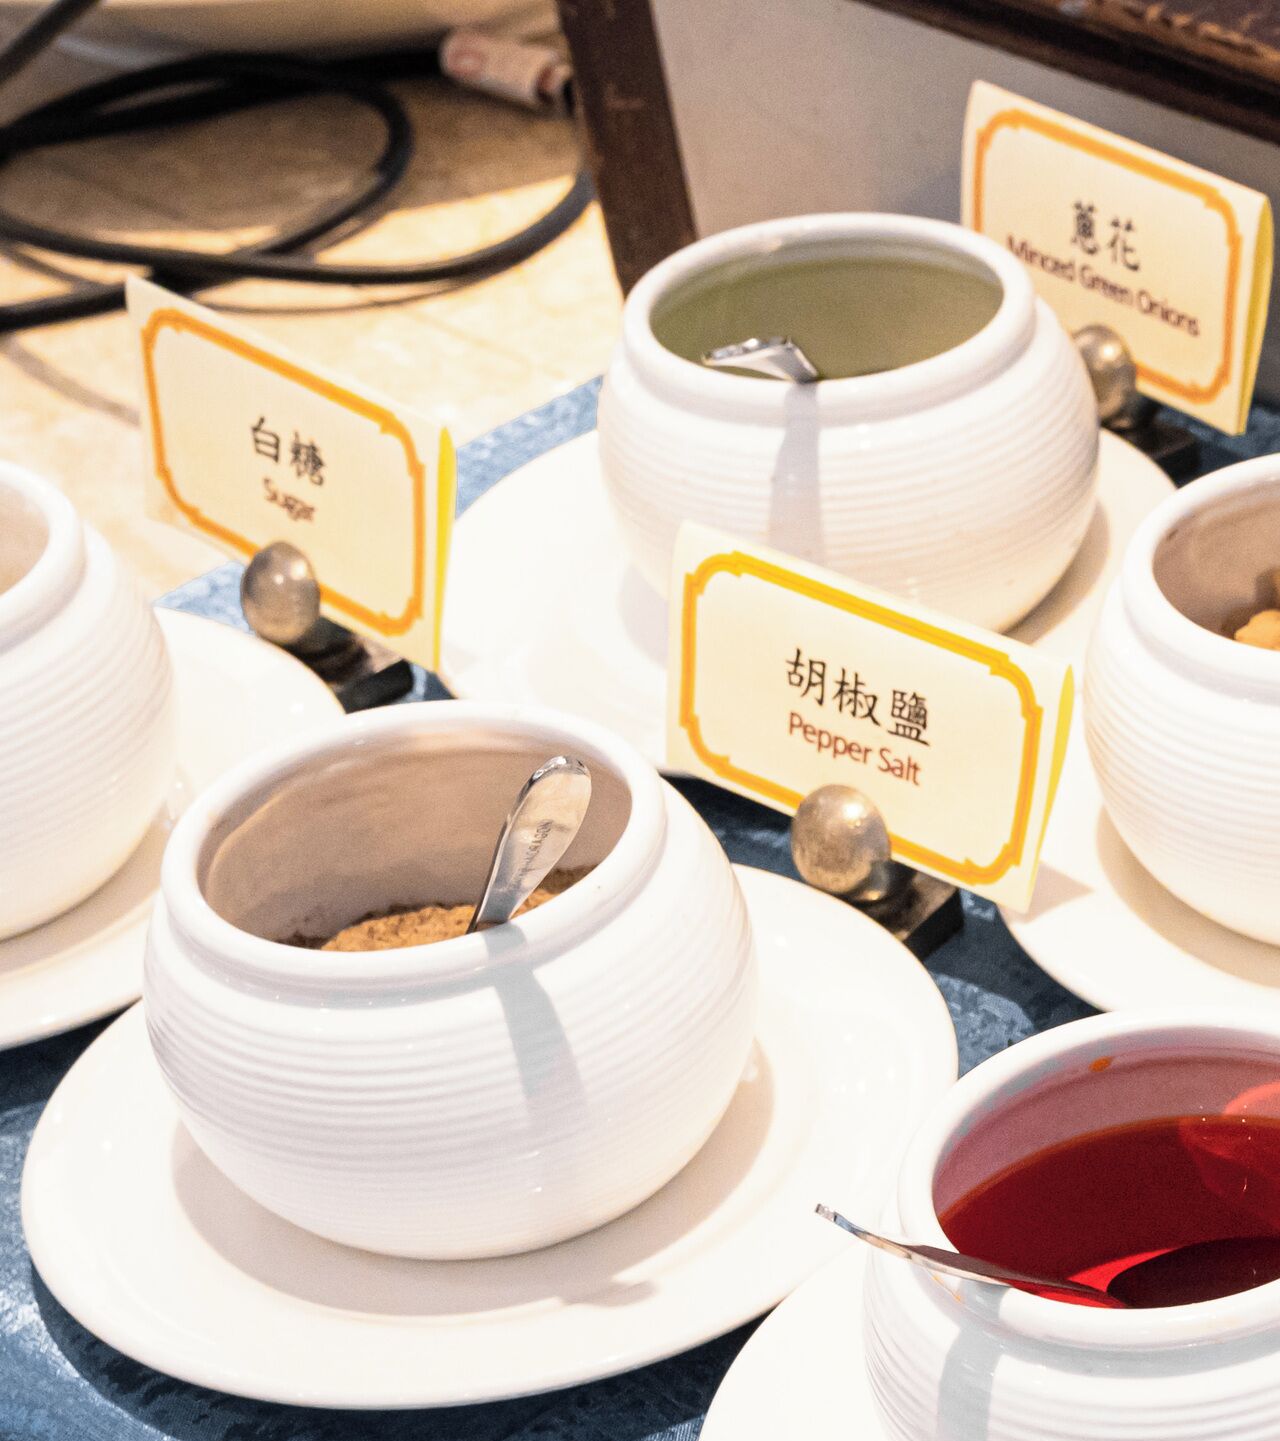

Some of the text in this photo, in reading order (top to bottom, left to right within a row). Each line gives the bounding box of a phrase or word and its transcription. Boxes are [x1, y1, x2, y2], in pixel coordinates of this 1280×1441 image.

[1006, 233, 1200, 337] Minced Green Onions
[251, 416, 325, 486] 白糖
[263, 477, 316, 522] Sugar
[785, 648, 931, 746] 胡椒鹽
[788, 711, 921, 786] Pepper Salt
